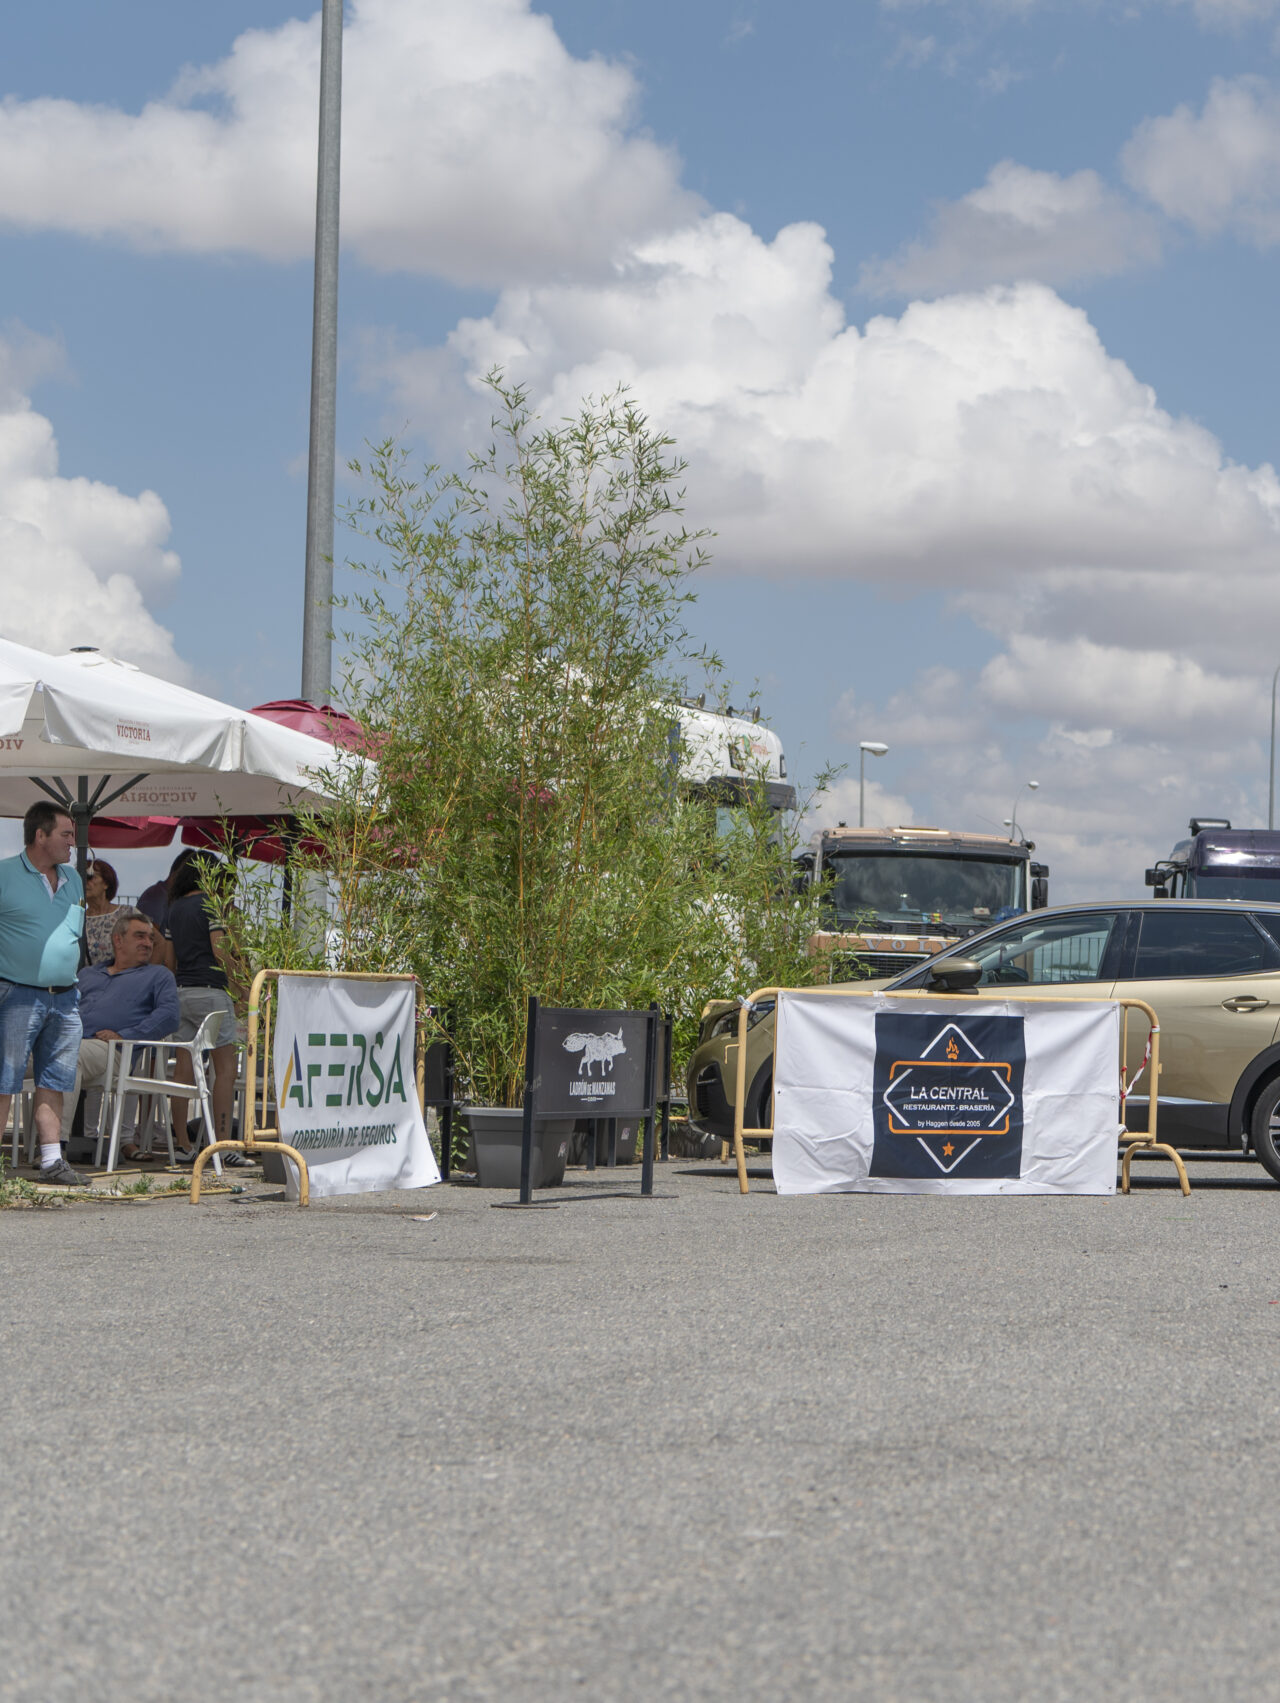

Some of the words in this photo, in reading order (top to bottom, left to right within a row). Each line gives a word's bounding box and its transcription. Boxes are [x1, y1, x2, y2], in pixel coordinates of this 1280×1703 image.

[116, 724, 151, 741] VICTORIA
[864, 938, 959, 953] VOLV
[280, 1031, 408, 1109] AFERSA
[910, 1086, 928, 1100] LA
[929, 1086, 989, 1101] CENTRAL
[903, 1103, 955, 1111] RESTAURANTE
[917, 1119, 924, 1128] by
[949, 1119, 966, 1128] desde
[290, 1121, 343, 1150] CORREDURÍA
[345, 1126, 359, 1147] DE
[360, 1123, 398, 1146] SEGUROS
